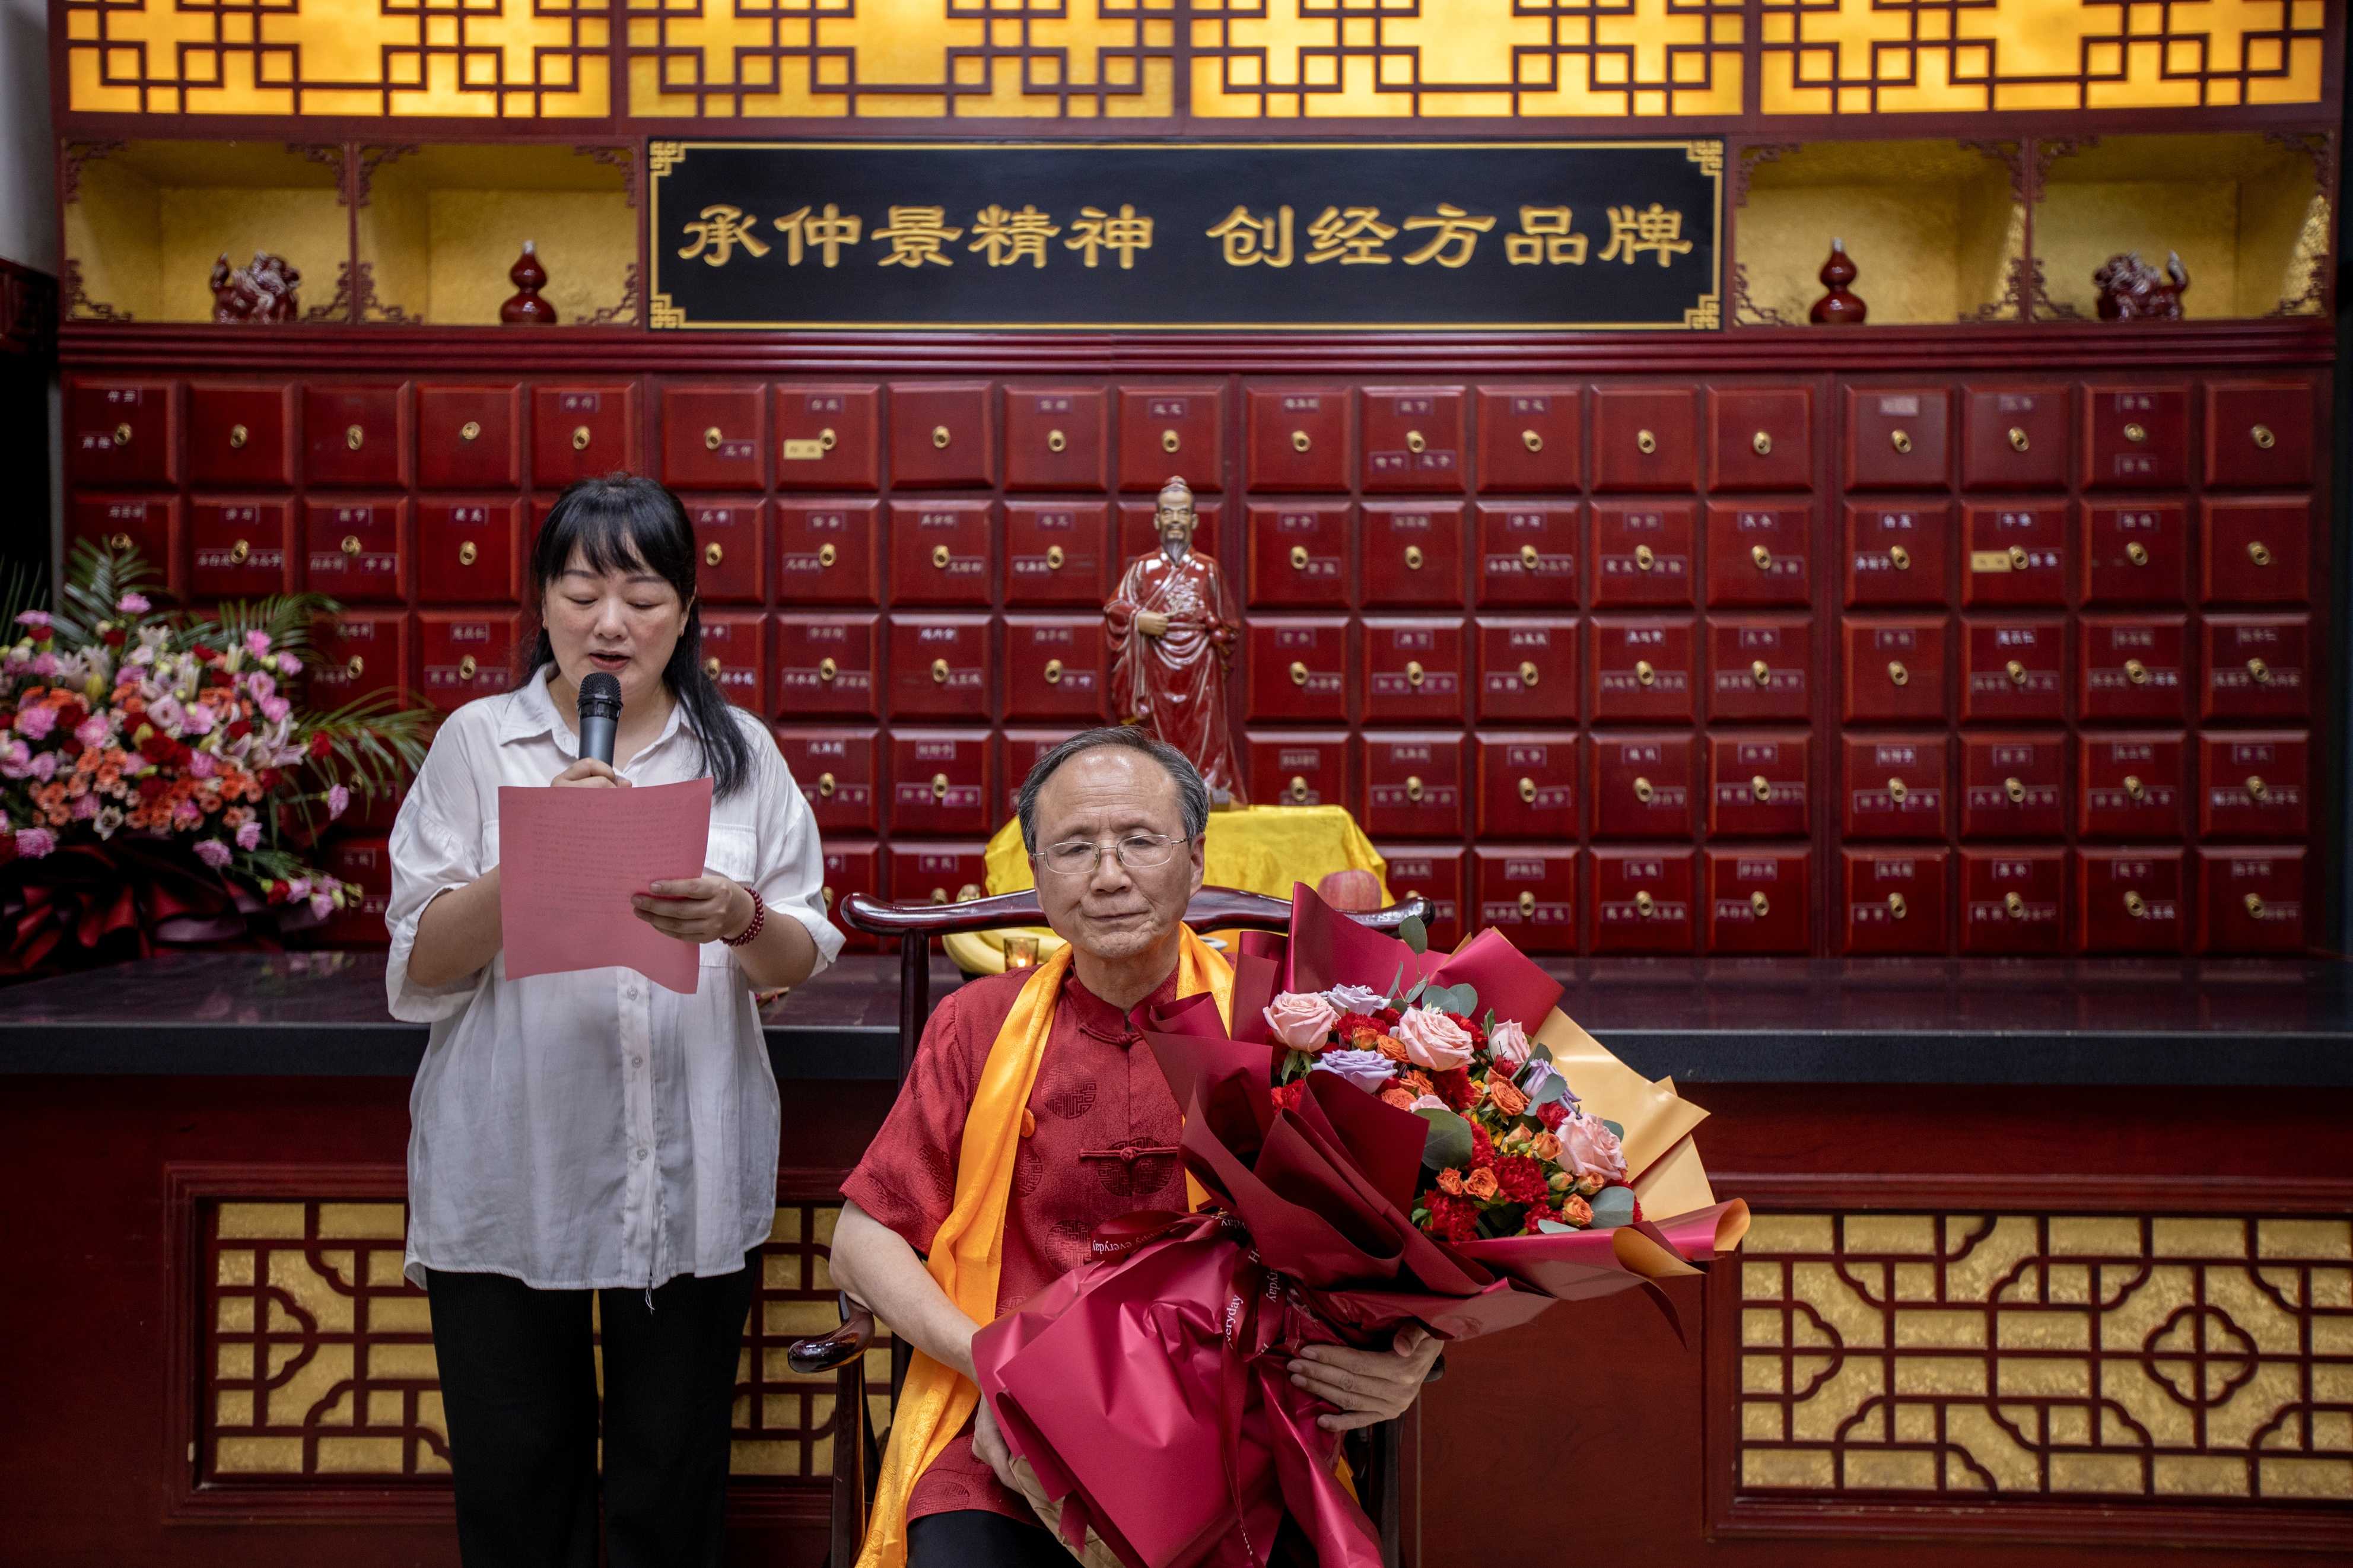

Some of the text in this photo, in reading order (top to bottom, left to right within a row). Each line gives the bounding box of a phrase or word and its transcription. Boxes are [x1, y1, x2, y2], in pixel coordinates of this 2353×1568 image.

[678, 203, 1693, 269] 承仲景精神 创经方品牌
[1221, 1218, 1247, 1230] yday
[1092, 1239, 1132, 1255] everyday
[1266, 1268, 1280, 1303] eryday
